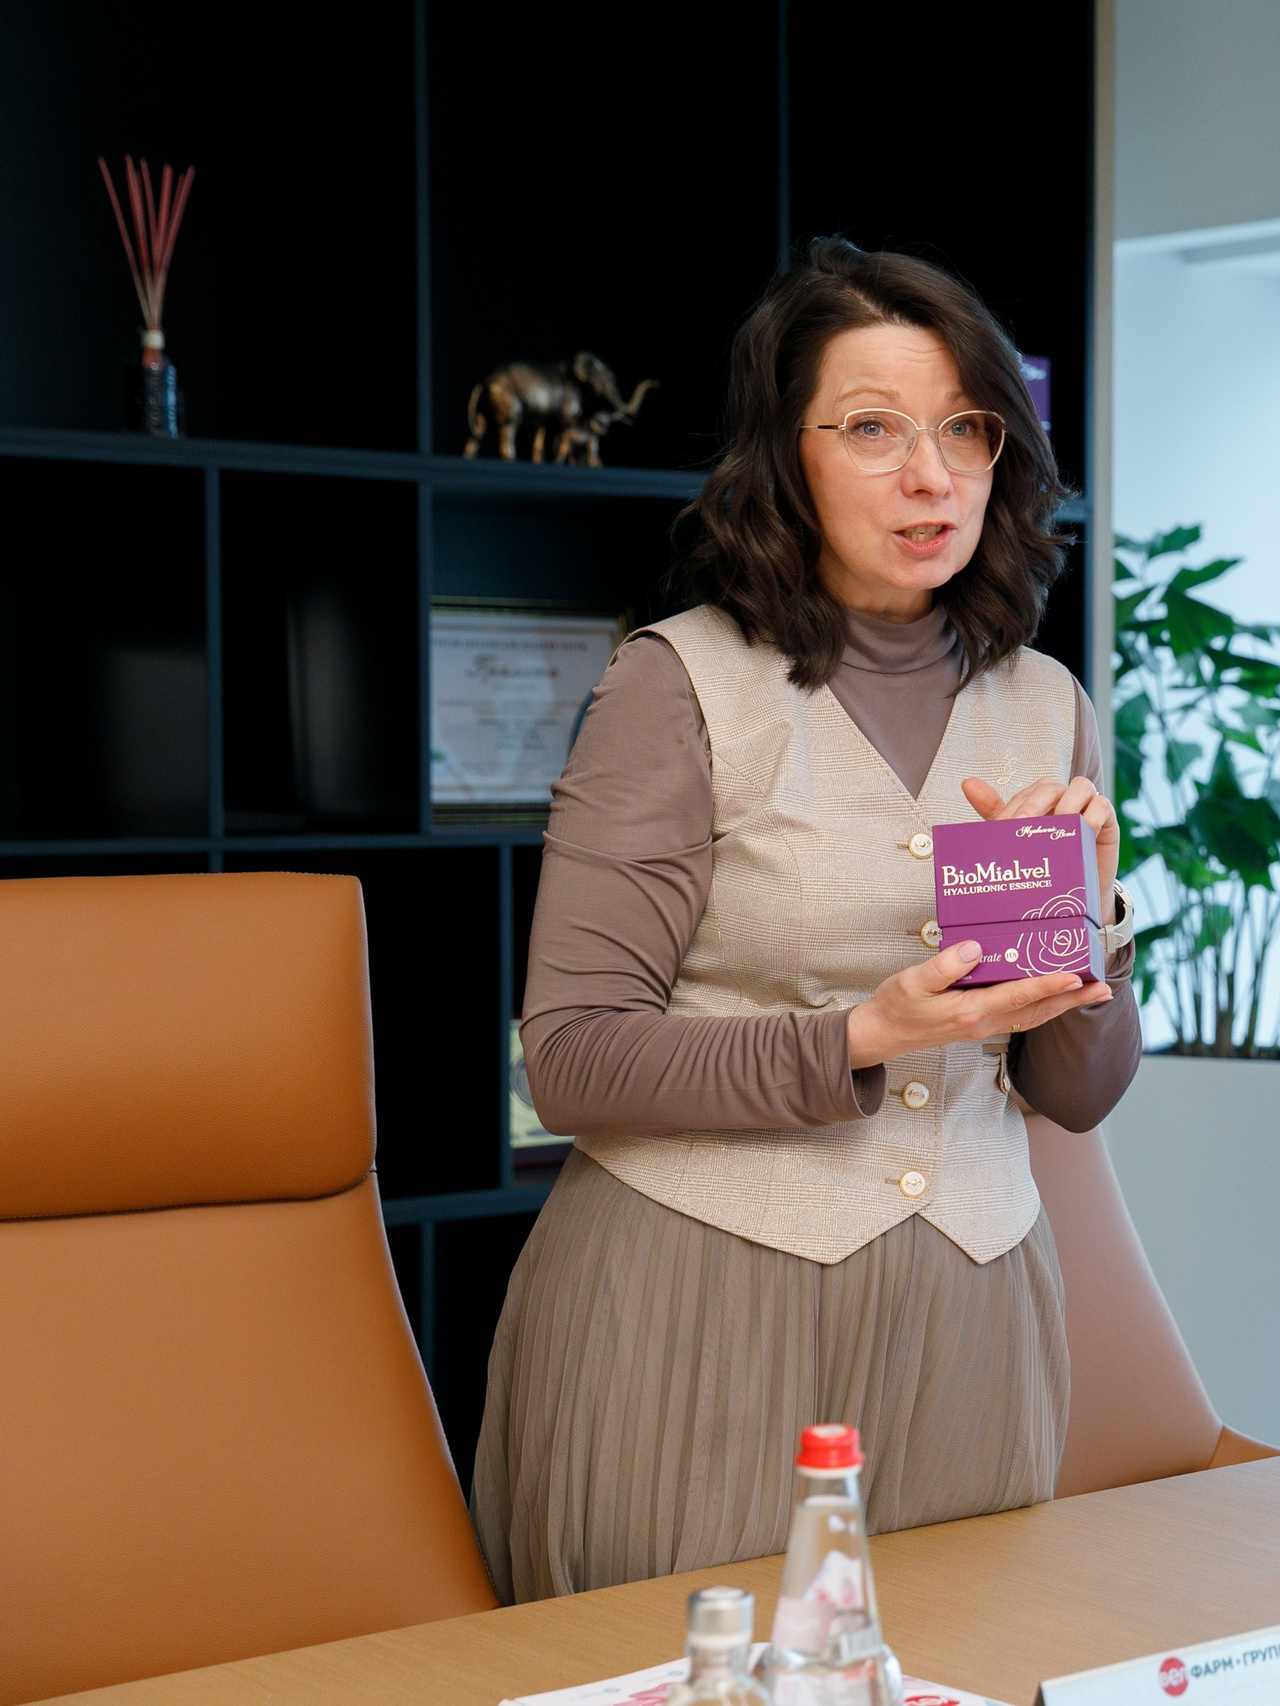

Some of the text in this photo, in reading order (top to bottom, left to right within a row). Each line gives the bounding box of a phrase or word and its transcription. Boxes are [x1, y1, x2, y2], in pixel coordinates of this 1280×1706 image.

[941, 857, 1052, 887] BioMialvel
[943, 879, 1053, 897] HYALURONIC ESSENCE
